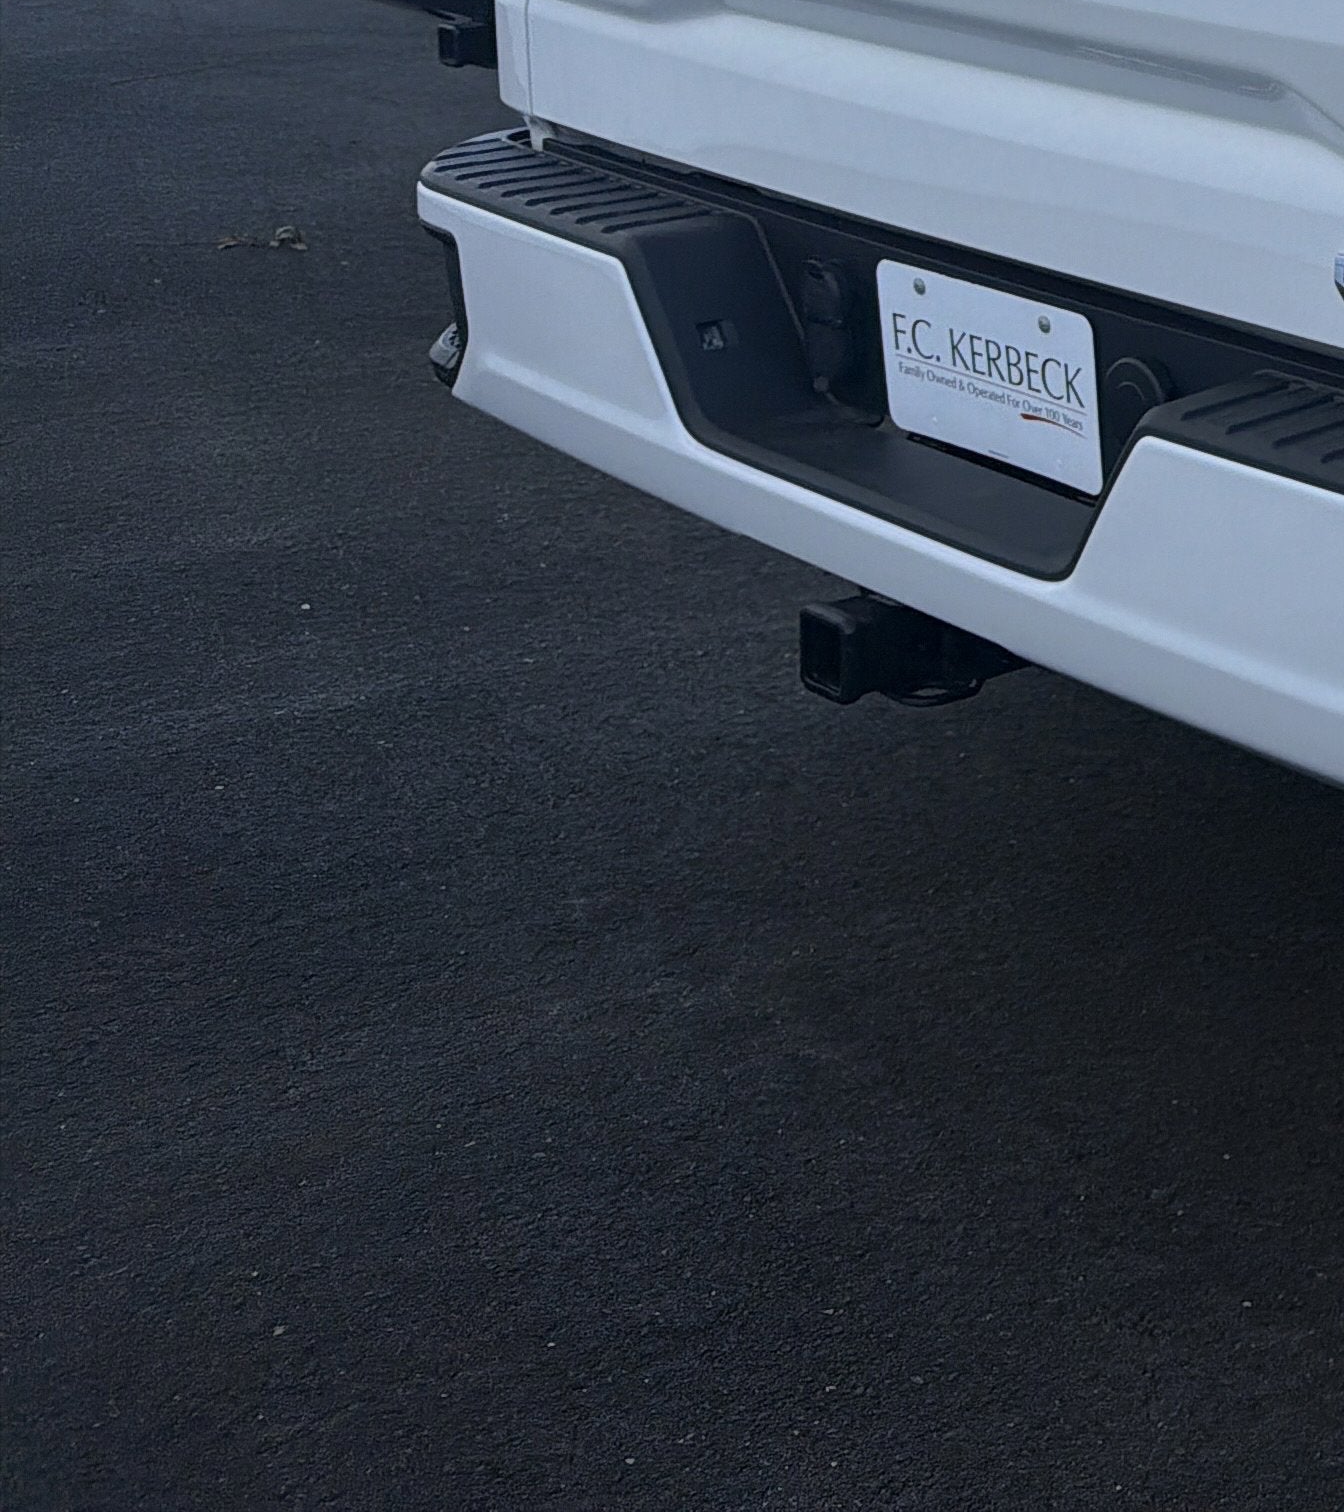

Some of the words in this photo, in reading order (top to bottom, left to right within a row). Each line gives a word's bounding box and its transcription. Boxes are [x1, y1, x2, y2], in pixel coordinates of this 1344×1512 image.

[891, 312, 942, 363] F.C.
[949, 327, 1085, 409] KERBECK
[898, 361, 925, 382] Family
[926, 370, 957, 391] Owned
[958, 379, 966, 392] &
[966, 382, 1005, 406] Operated
[1007, 395, 1021, 409] For
[1022, 399, 1043, 416] Over
[1044, 406, 1060, 422] 100
[1061, 412, 1084, 431] Years
